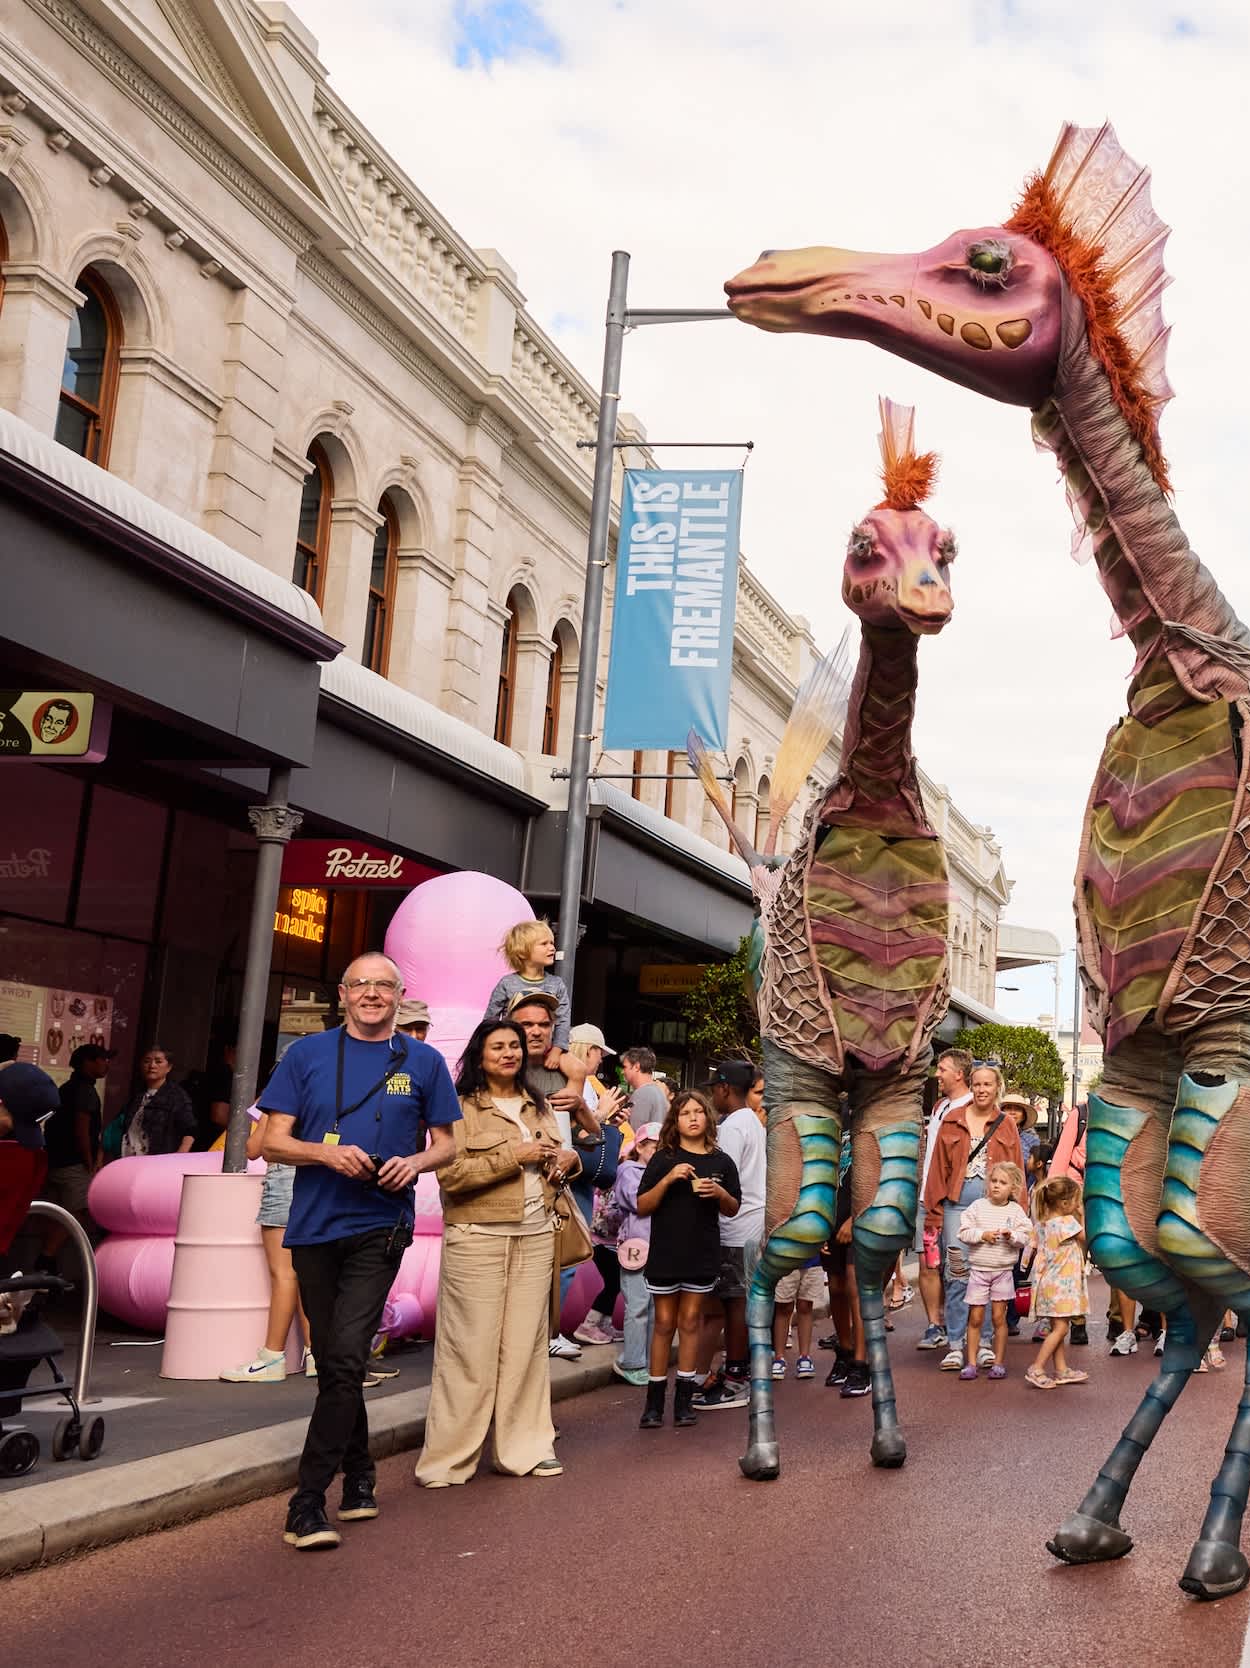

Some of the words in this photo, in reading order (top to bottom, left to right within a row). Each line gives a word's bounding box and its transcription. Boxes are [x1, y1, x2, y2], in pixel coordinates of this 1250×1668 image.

[632, 481, 680, 514] IS
[626, 521, 677, 597] THIS
[669, 481, 730, 668] FREMANTLE
[325, 847, 404, 879] Pretzel
[627, 1247, 641, 1262] R
